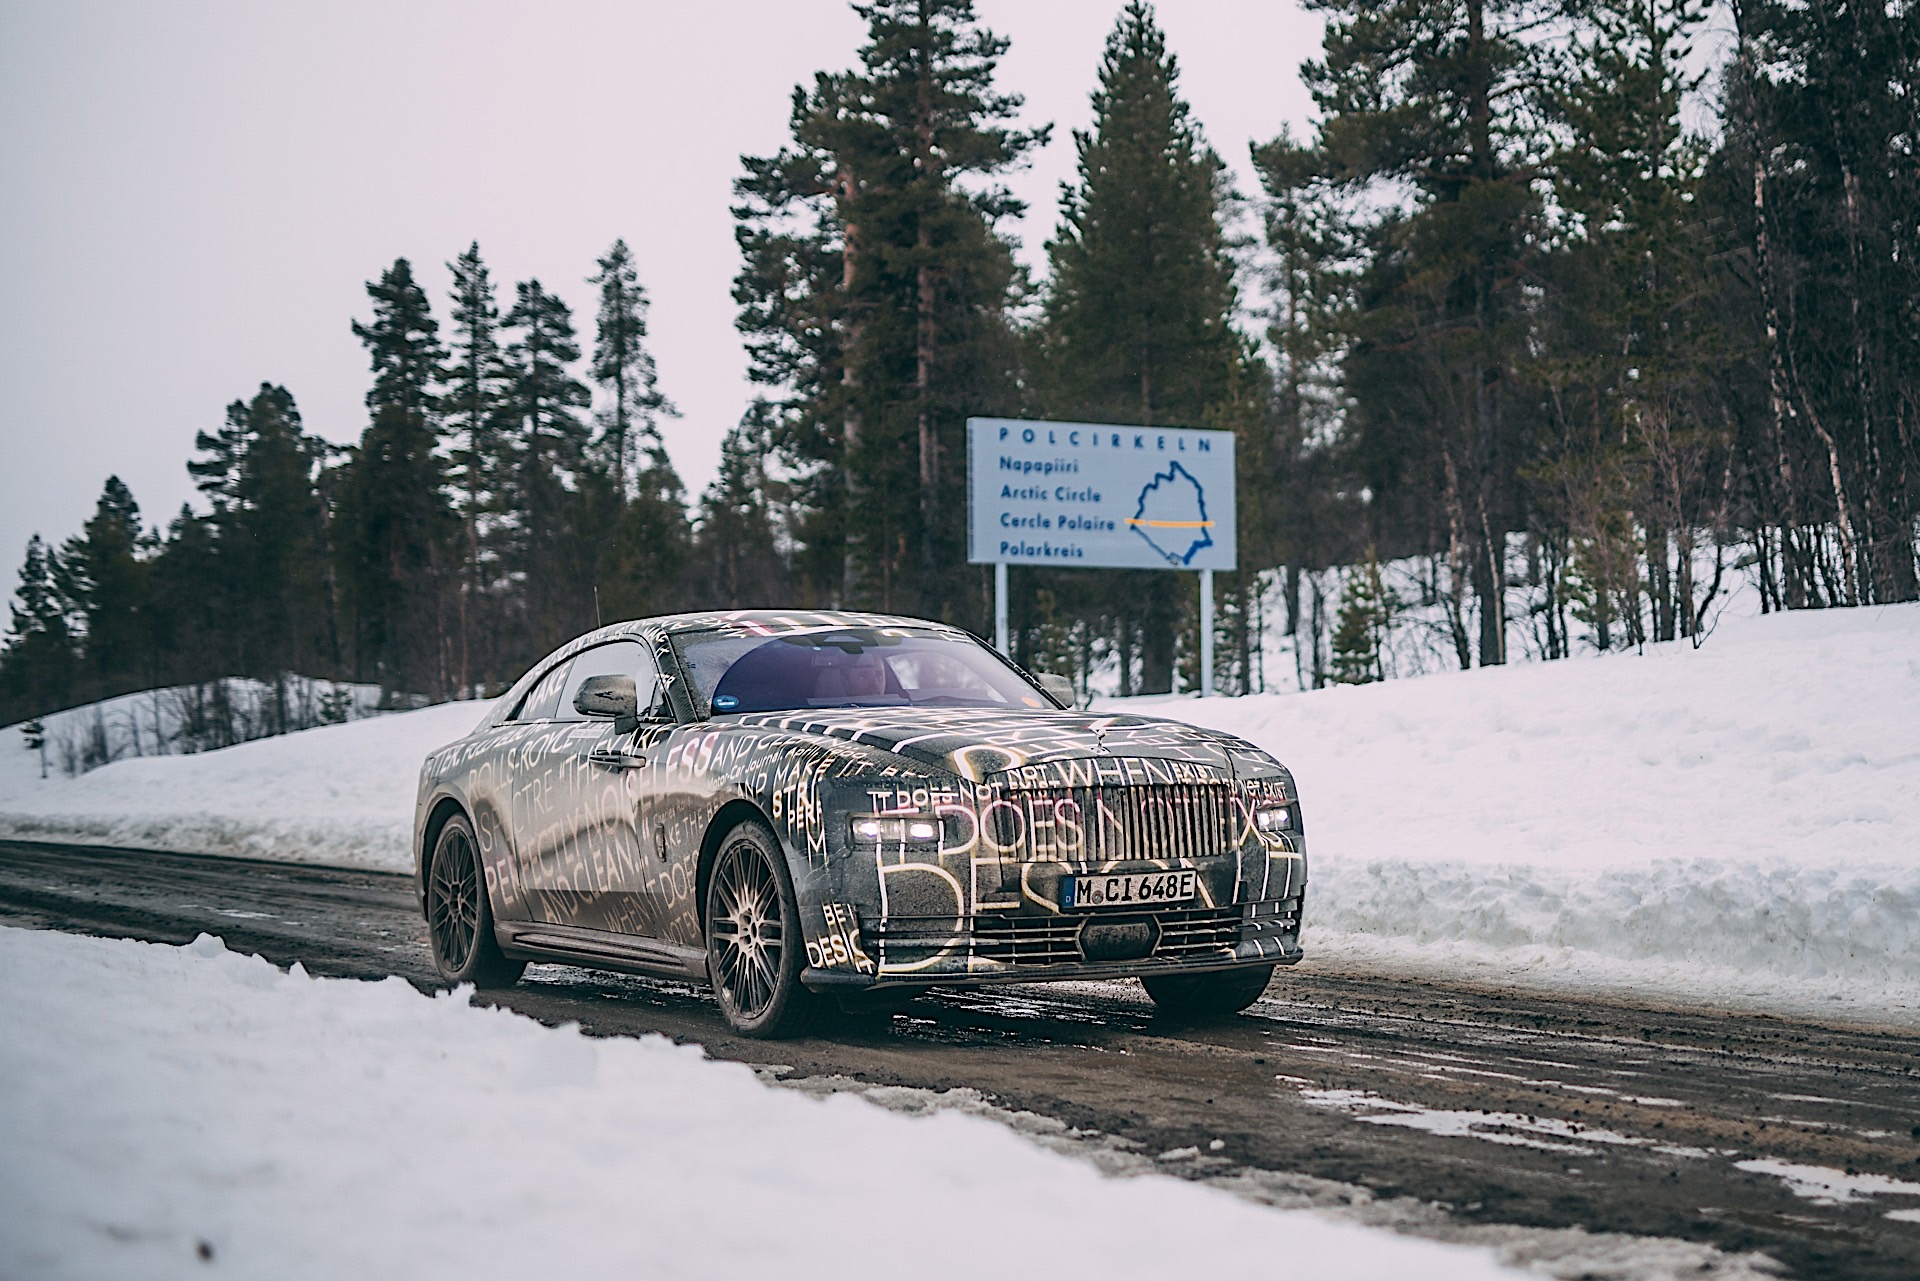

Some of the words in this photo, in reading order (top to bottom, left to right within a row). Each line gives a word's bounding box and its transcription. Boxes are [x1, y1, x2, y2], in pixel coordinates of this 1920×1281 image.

[999, 427, 1212, 452] POLCIRKELN
[999, 456, 1079, 475] Napapiiri
[1000, 484, 1048, 500] Arctic
[1055, 486, 1102, 502] Circle
[1000, 512, 1050, 528] Cercle
[1058, 515, 1116, 531] Polaire
[1000, 540, 1084, 558] Polarkreis
[1053, 757, 1174, 787] WHEN
[1076, 879, 1092, 904] M
[1105, 877, 1133, 902] CI
[1138, 873, 1193, 900] 648E
